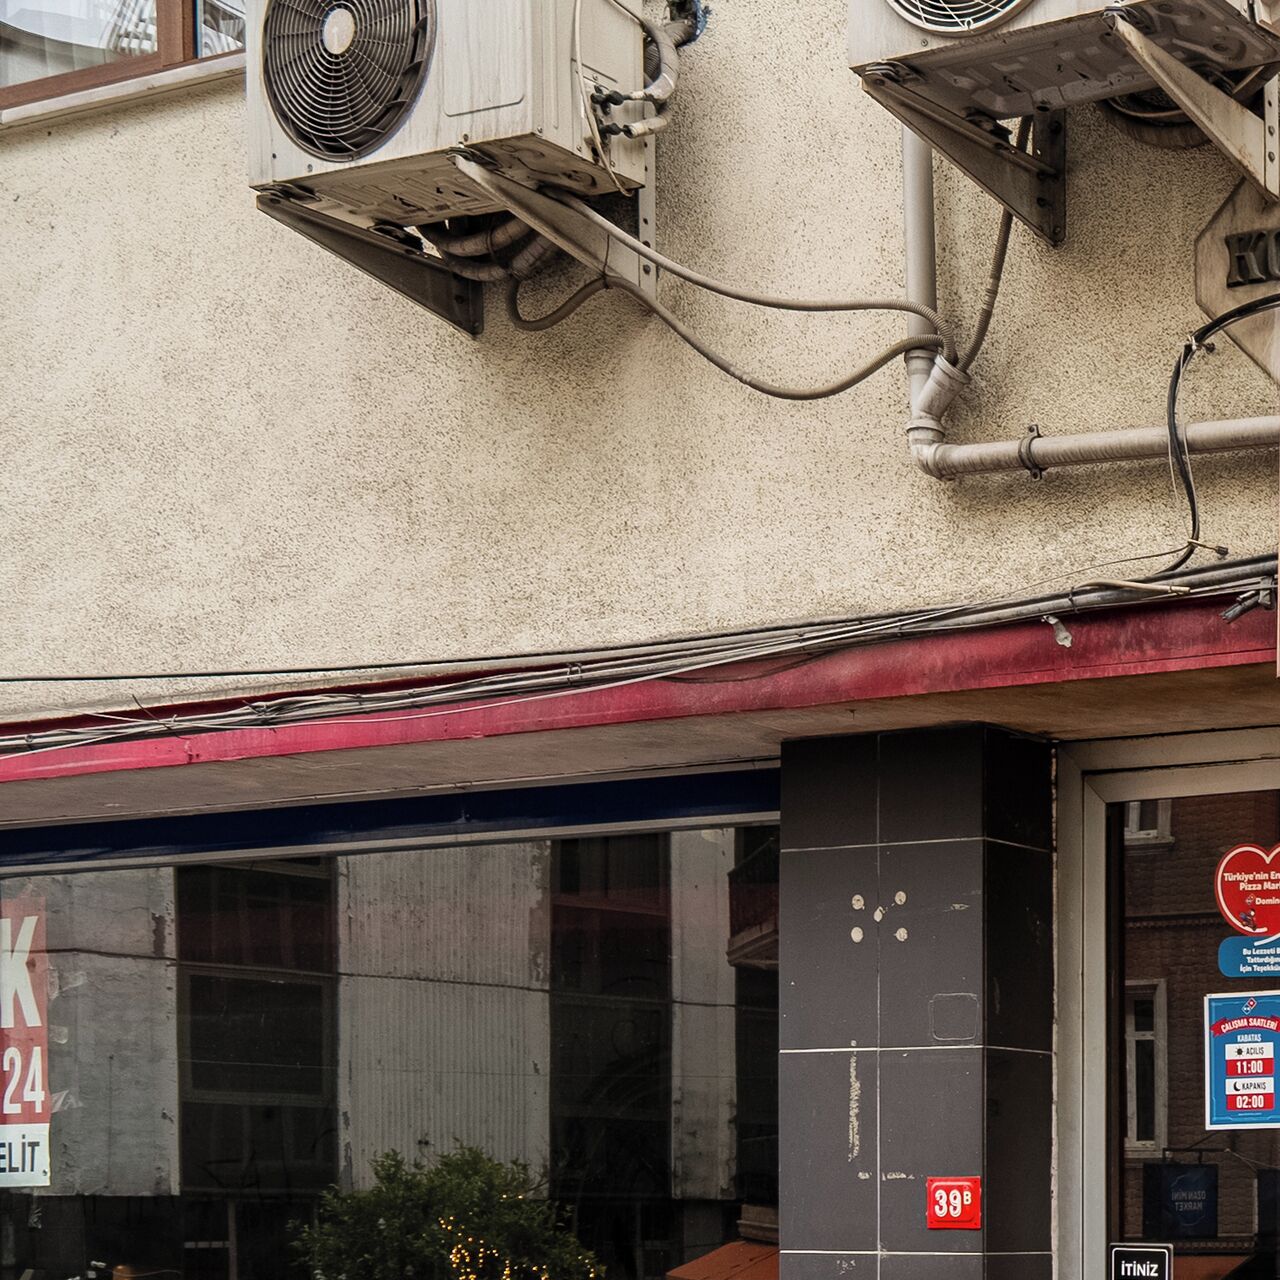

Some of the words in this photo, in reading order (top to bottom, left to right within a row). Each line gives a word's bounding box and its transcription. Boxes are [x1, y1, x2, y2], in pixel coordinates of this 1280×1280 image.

[1224, 872, 1268, 882] Türkiye'nin
[1270, 871, 1280, 879] En
[1239, 882, 1262, 891] Pizza
[1220, 1018, 1248, 1033] ÇALIŞMA
[1248, 1018, 1278, 1031] SAATLERİ
[1245, 1046, 1265, 1055] AÇILIŞ
[1236, 1060, 1263, 1074] 11:00
[1242, 1081, 1266, 1090] KAPANIŞ
[1236, 1095, 1264, 1109] 02:00
[1121, 1260, 1159, 1277] İTİNİZ
